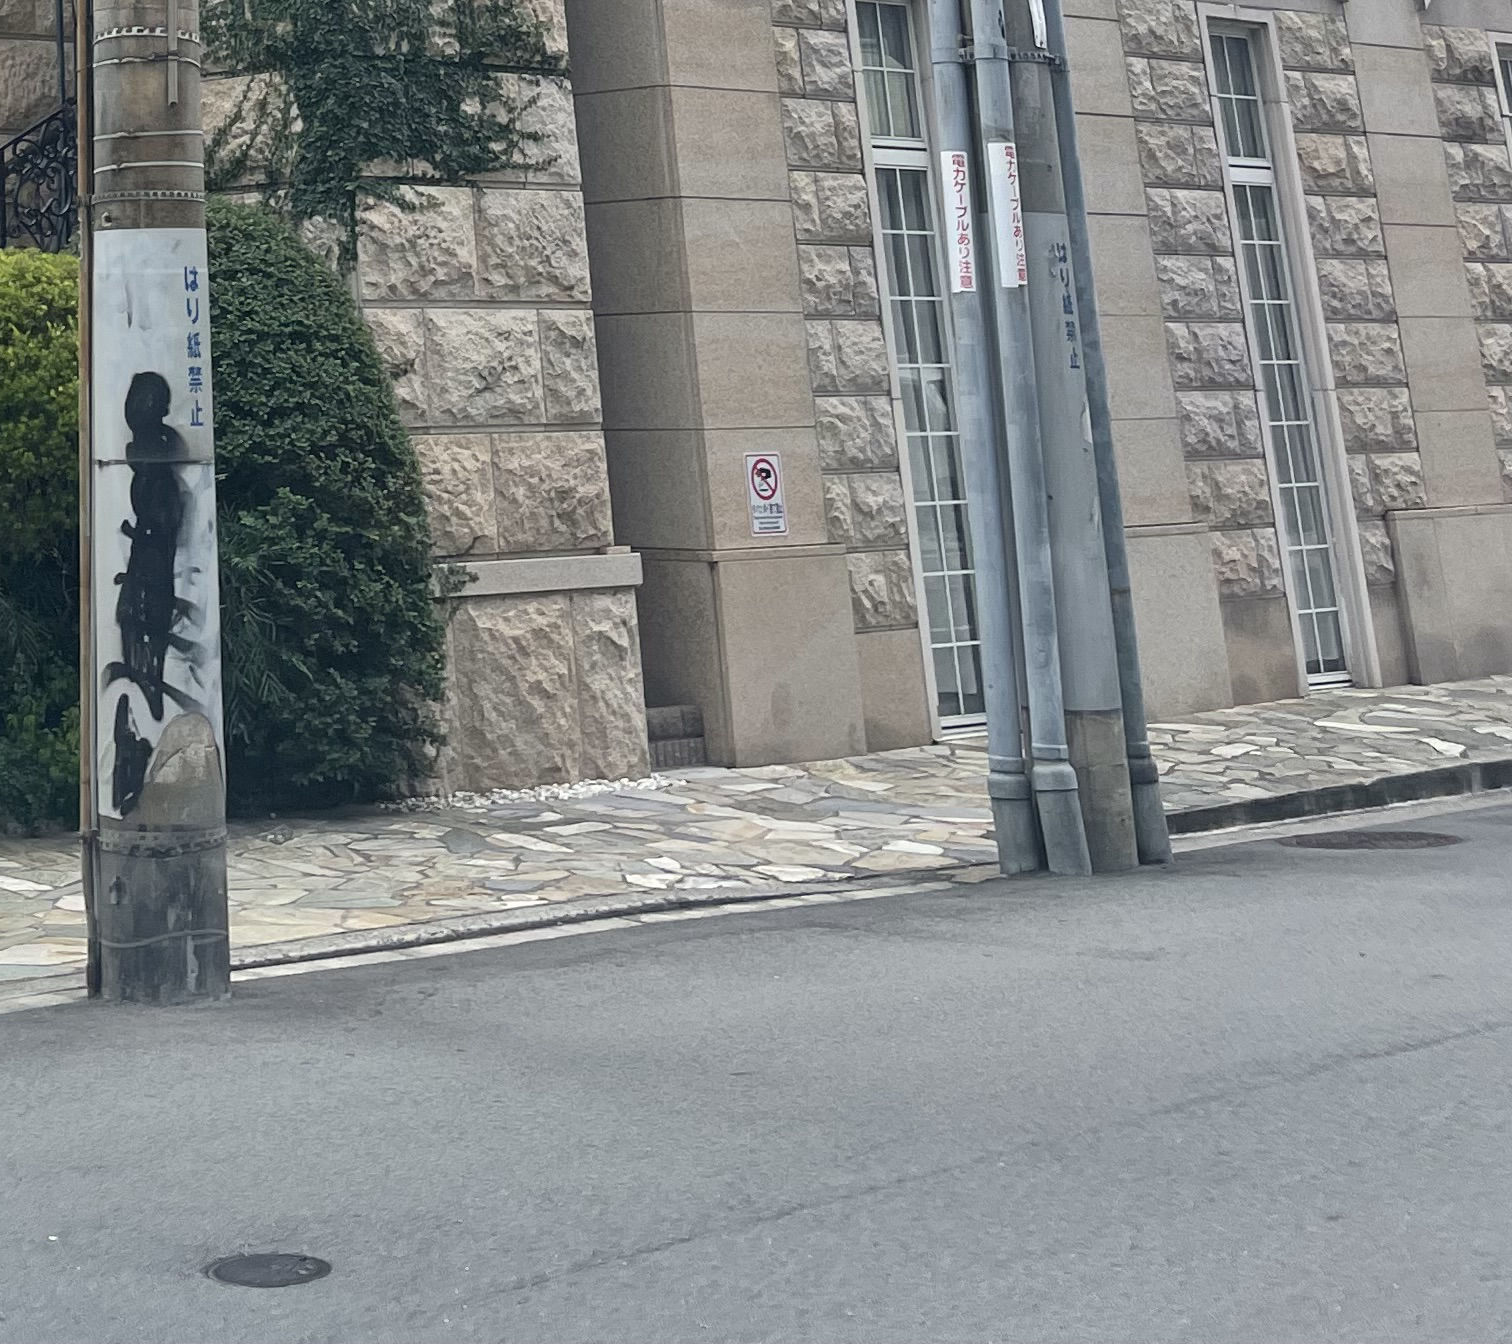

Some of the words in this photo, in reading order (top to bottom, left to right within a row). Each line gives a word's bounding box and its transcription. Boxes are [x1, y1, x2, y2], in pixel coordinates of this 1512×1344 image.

[951, 153, 974, 289] 電力ケーブルあり注意
[183, 265, 205, 428] はり紙禁止
